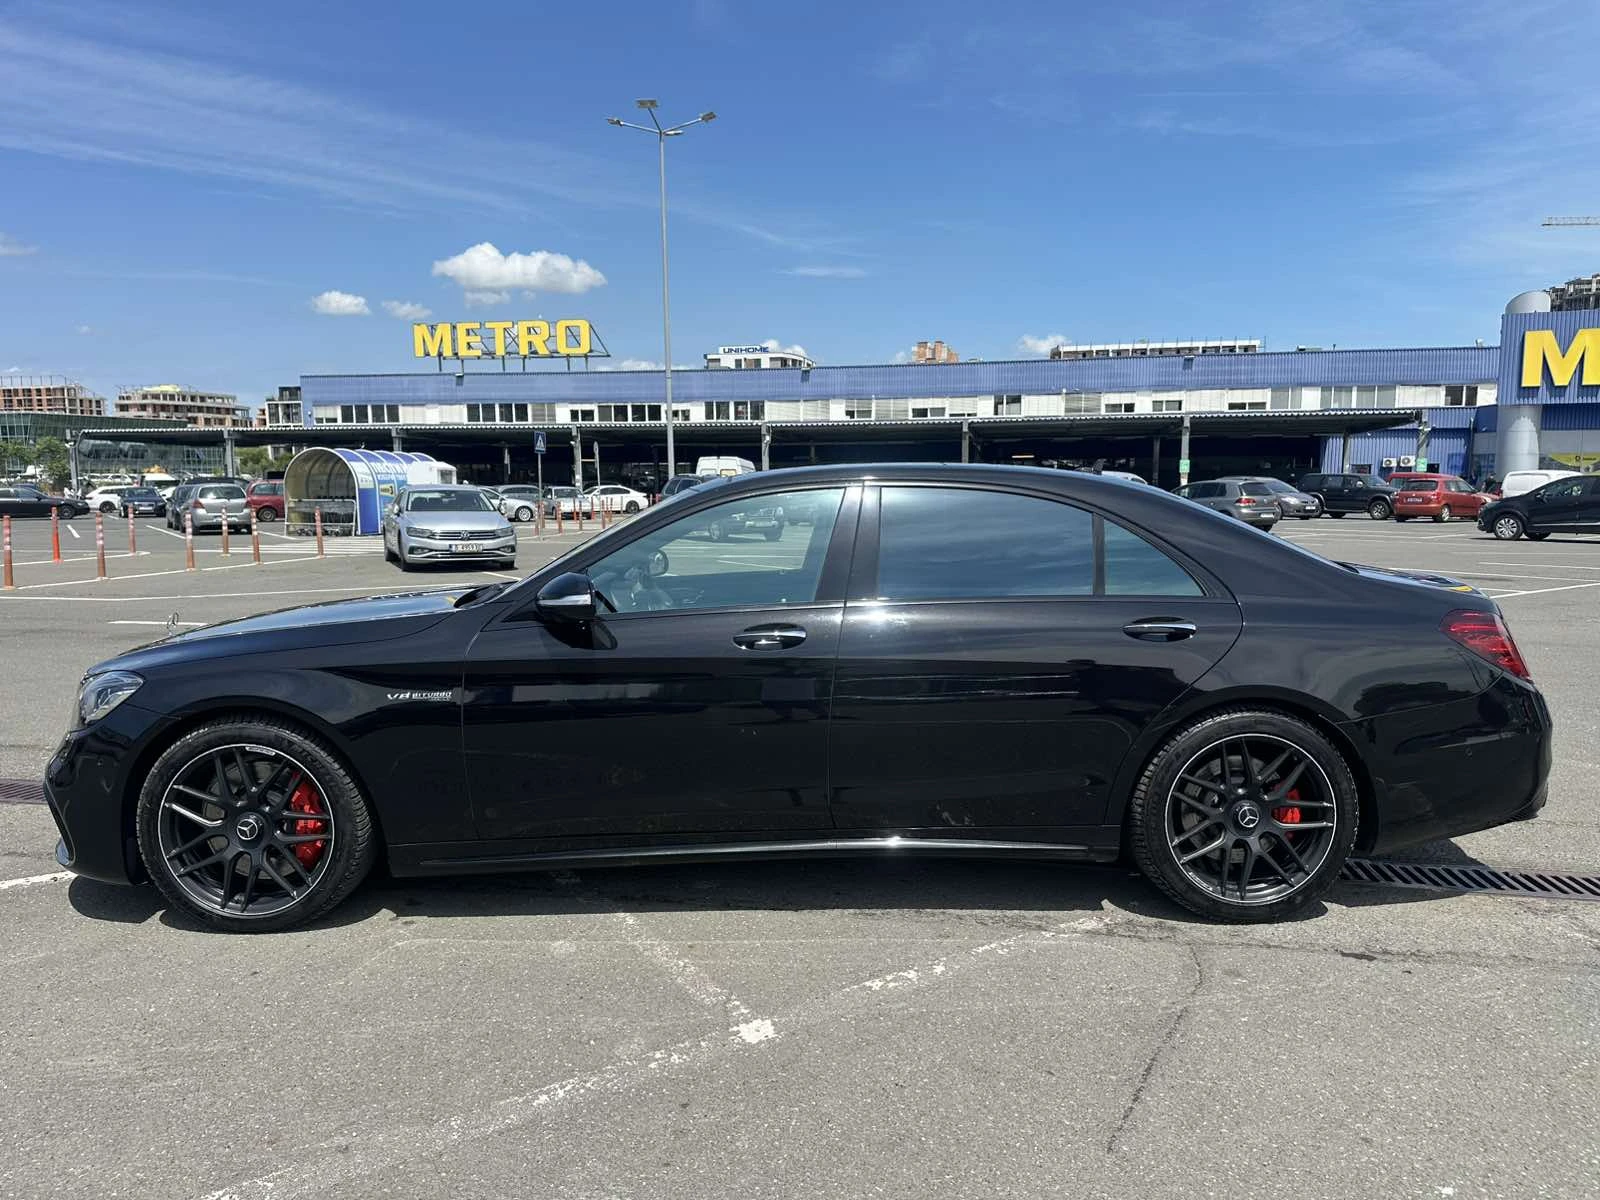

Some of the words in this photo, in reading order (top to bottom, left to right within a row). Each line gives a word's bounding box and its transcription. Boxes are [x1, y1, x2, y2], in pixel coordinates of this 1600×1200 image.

[413, 319, 591, 357] METRO
[1521, 328, 1600, 387] M
[386, 692, 410, 700] V8
